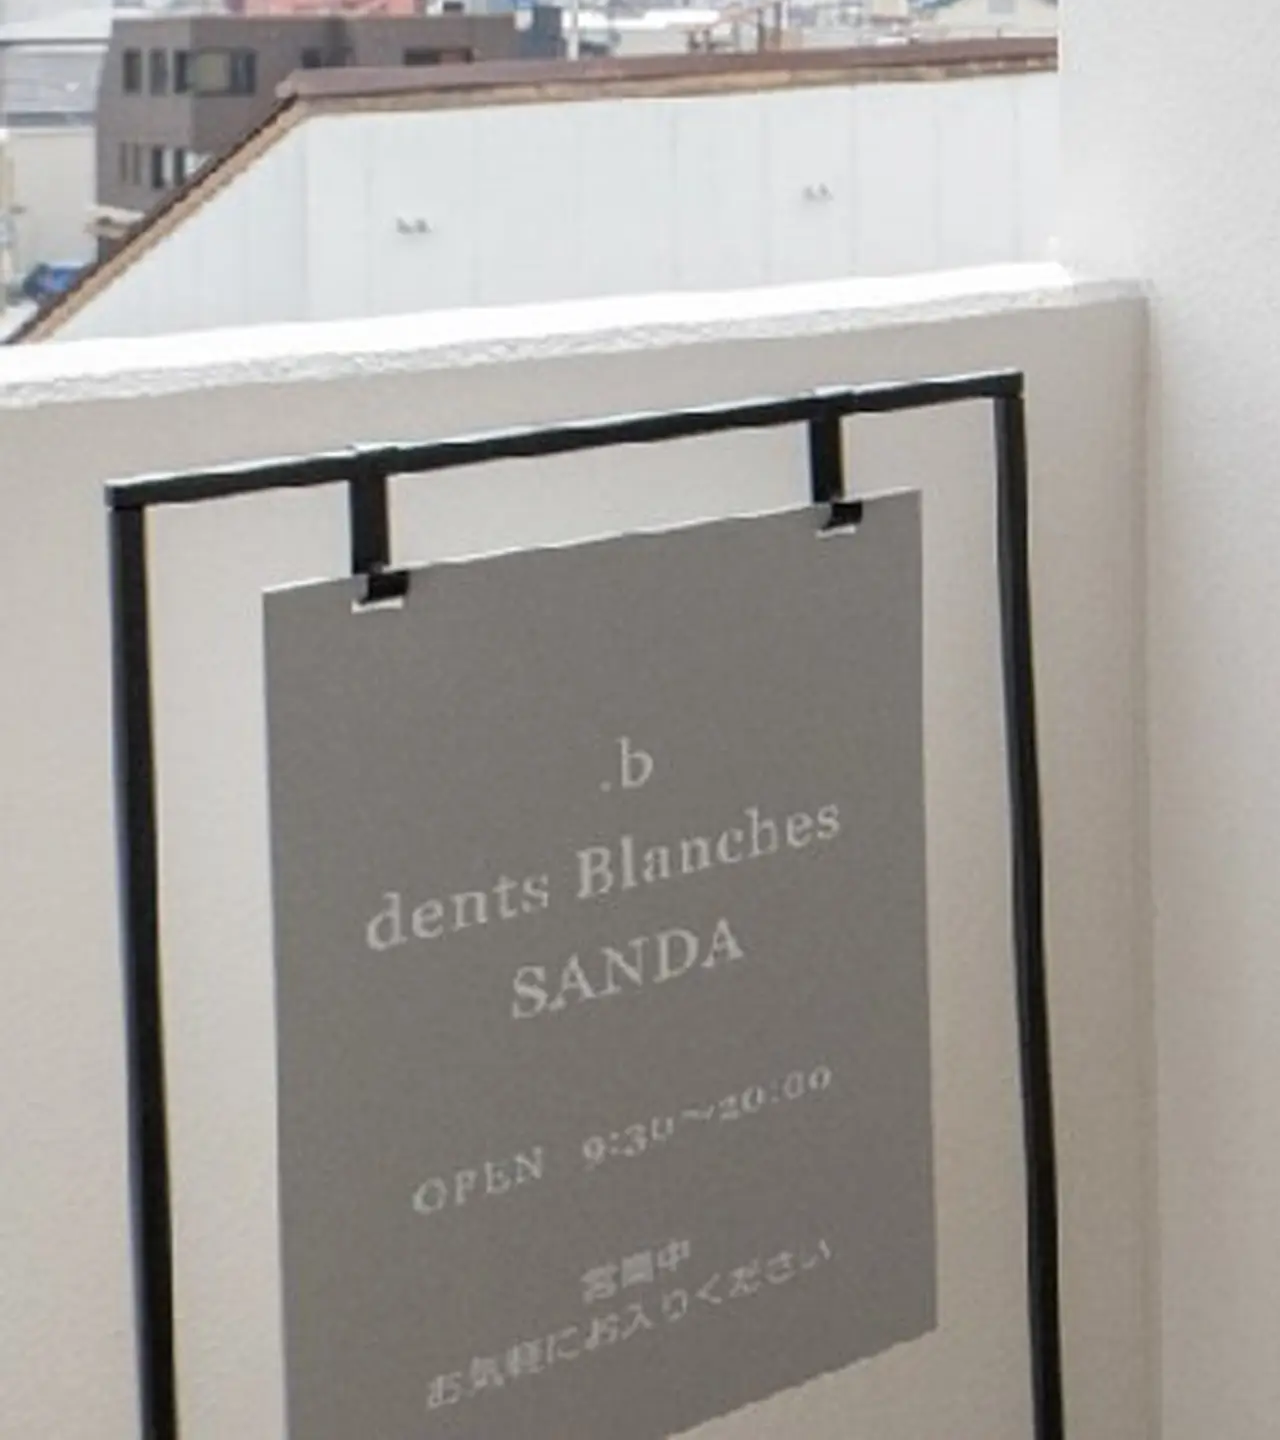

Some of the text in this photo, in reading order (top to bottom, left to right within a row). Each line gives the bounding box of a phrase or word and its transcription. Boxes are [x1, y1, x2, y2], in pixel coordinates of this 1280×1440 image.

[364, 800, 842, 953] dents Blanches
[511, 917, 746, 1020] SANDA
[412, 1146, 544, 1215] OPEN
